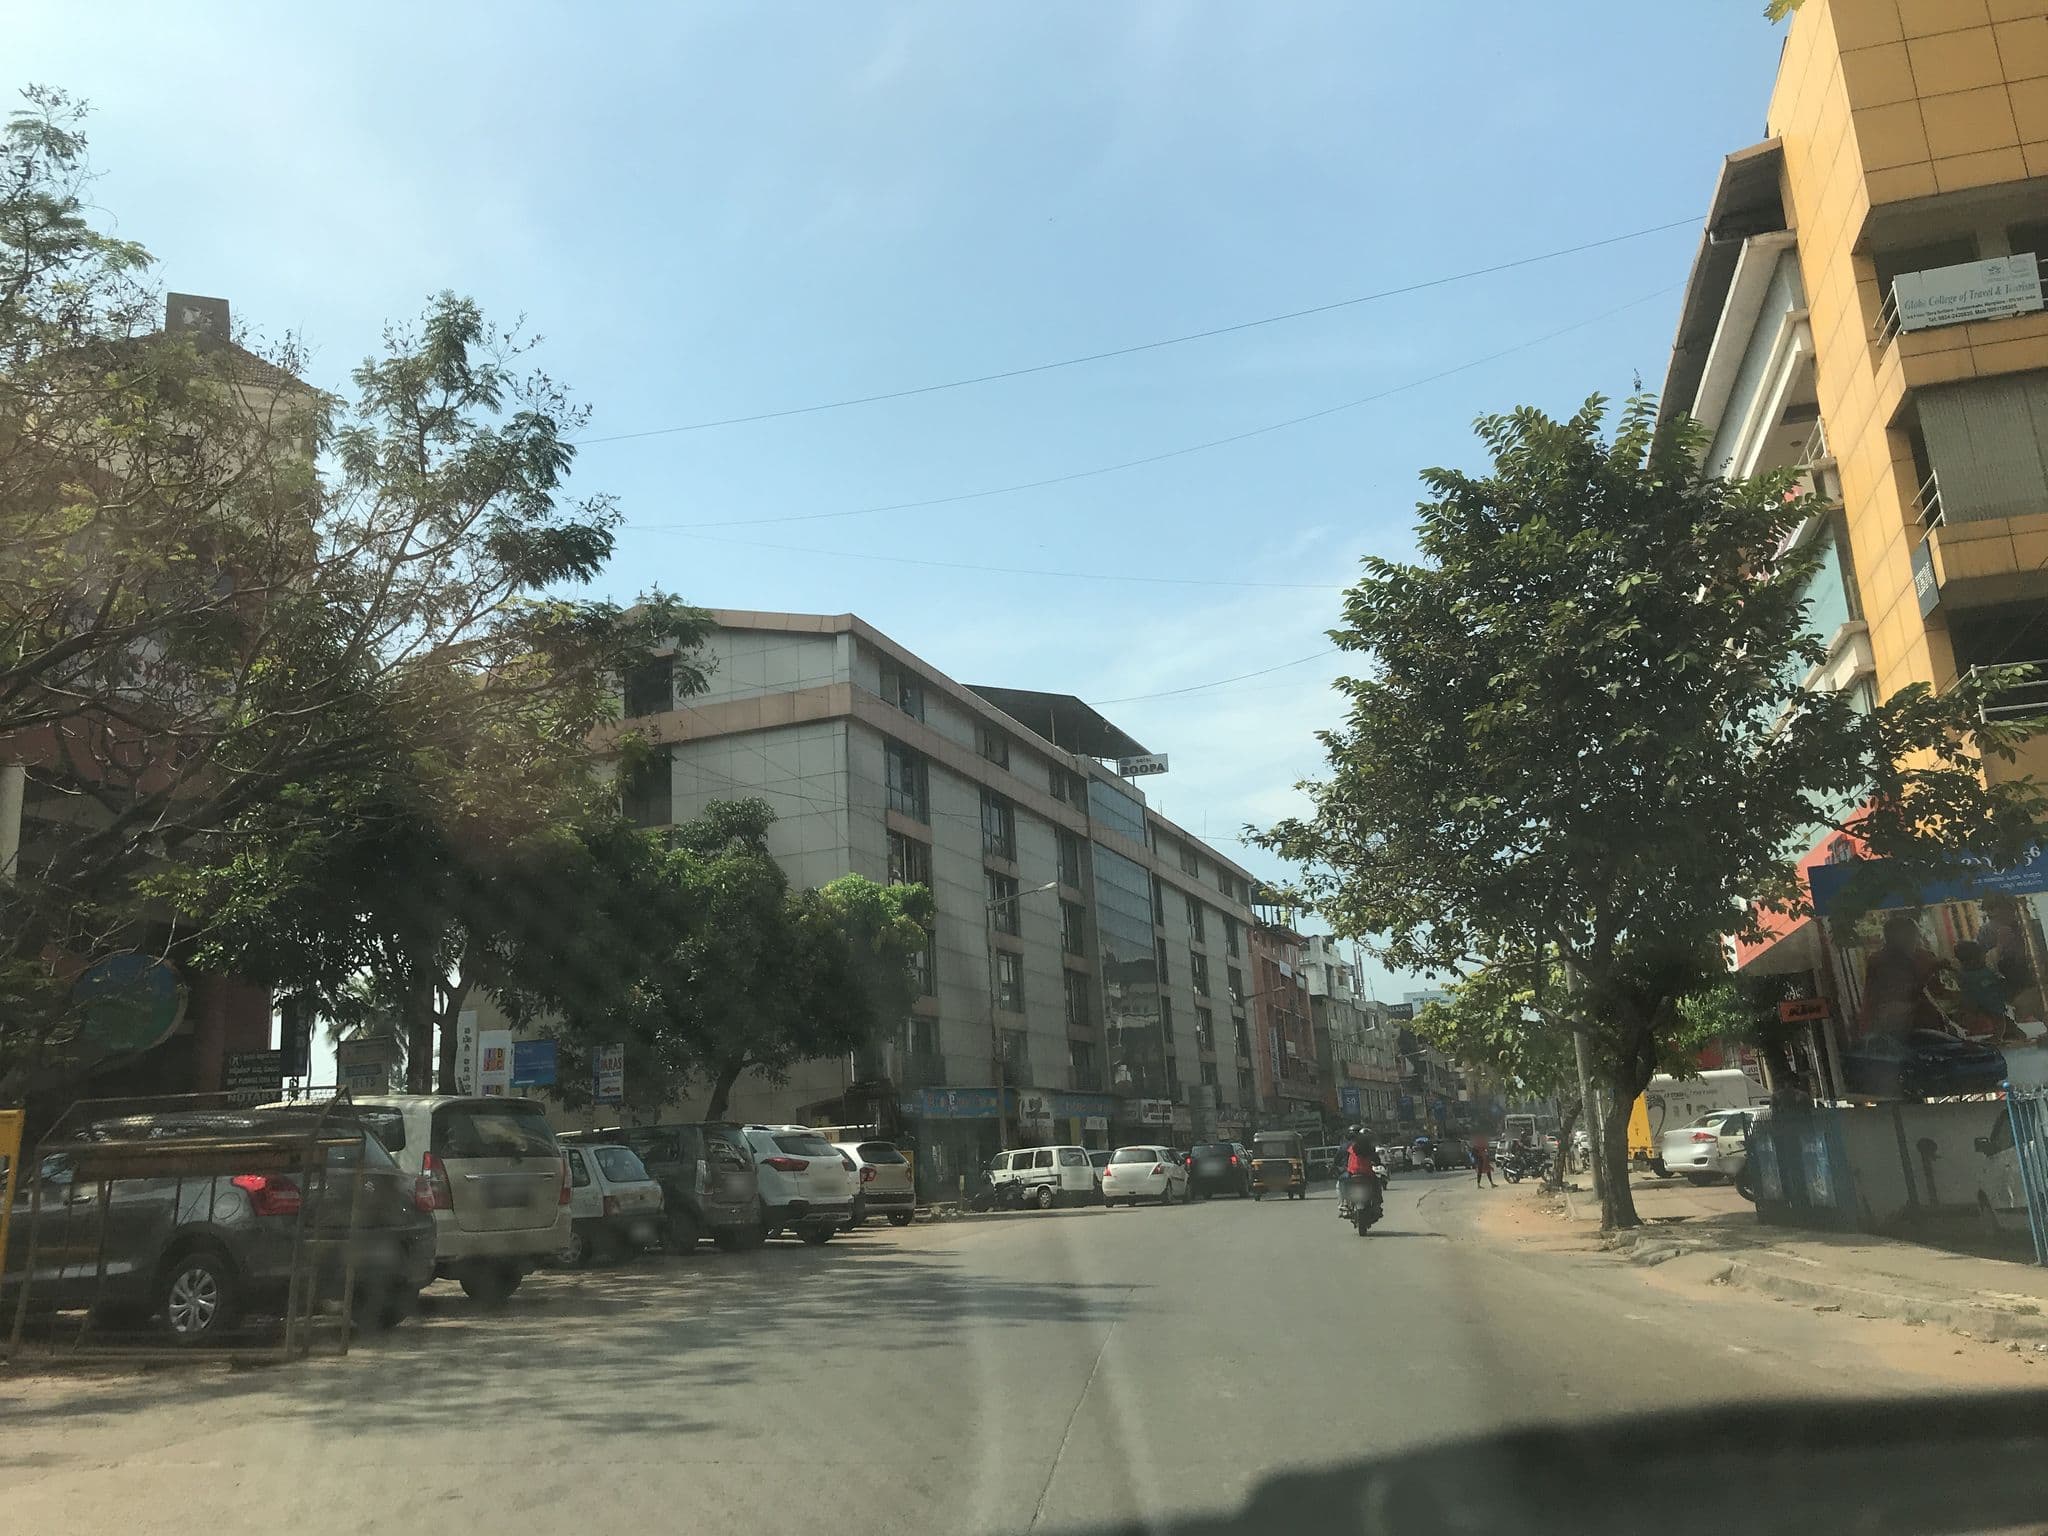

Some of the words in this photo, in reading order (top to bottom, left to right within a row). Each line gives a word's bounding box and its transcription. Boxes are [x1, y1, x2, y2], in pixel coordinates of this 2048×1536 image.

[1928, 294, 1957, 306] College
[1958, 290, 1967, 303] of
[1969, 287, 1993, 299] Travel
